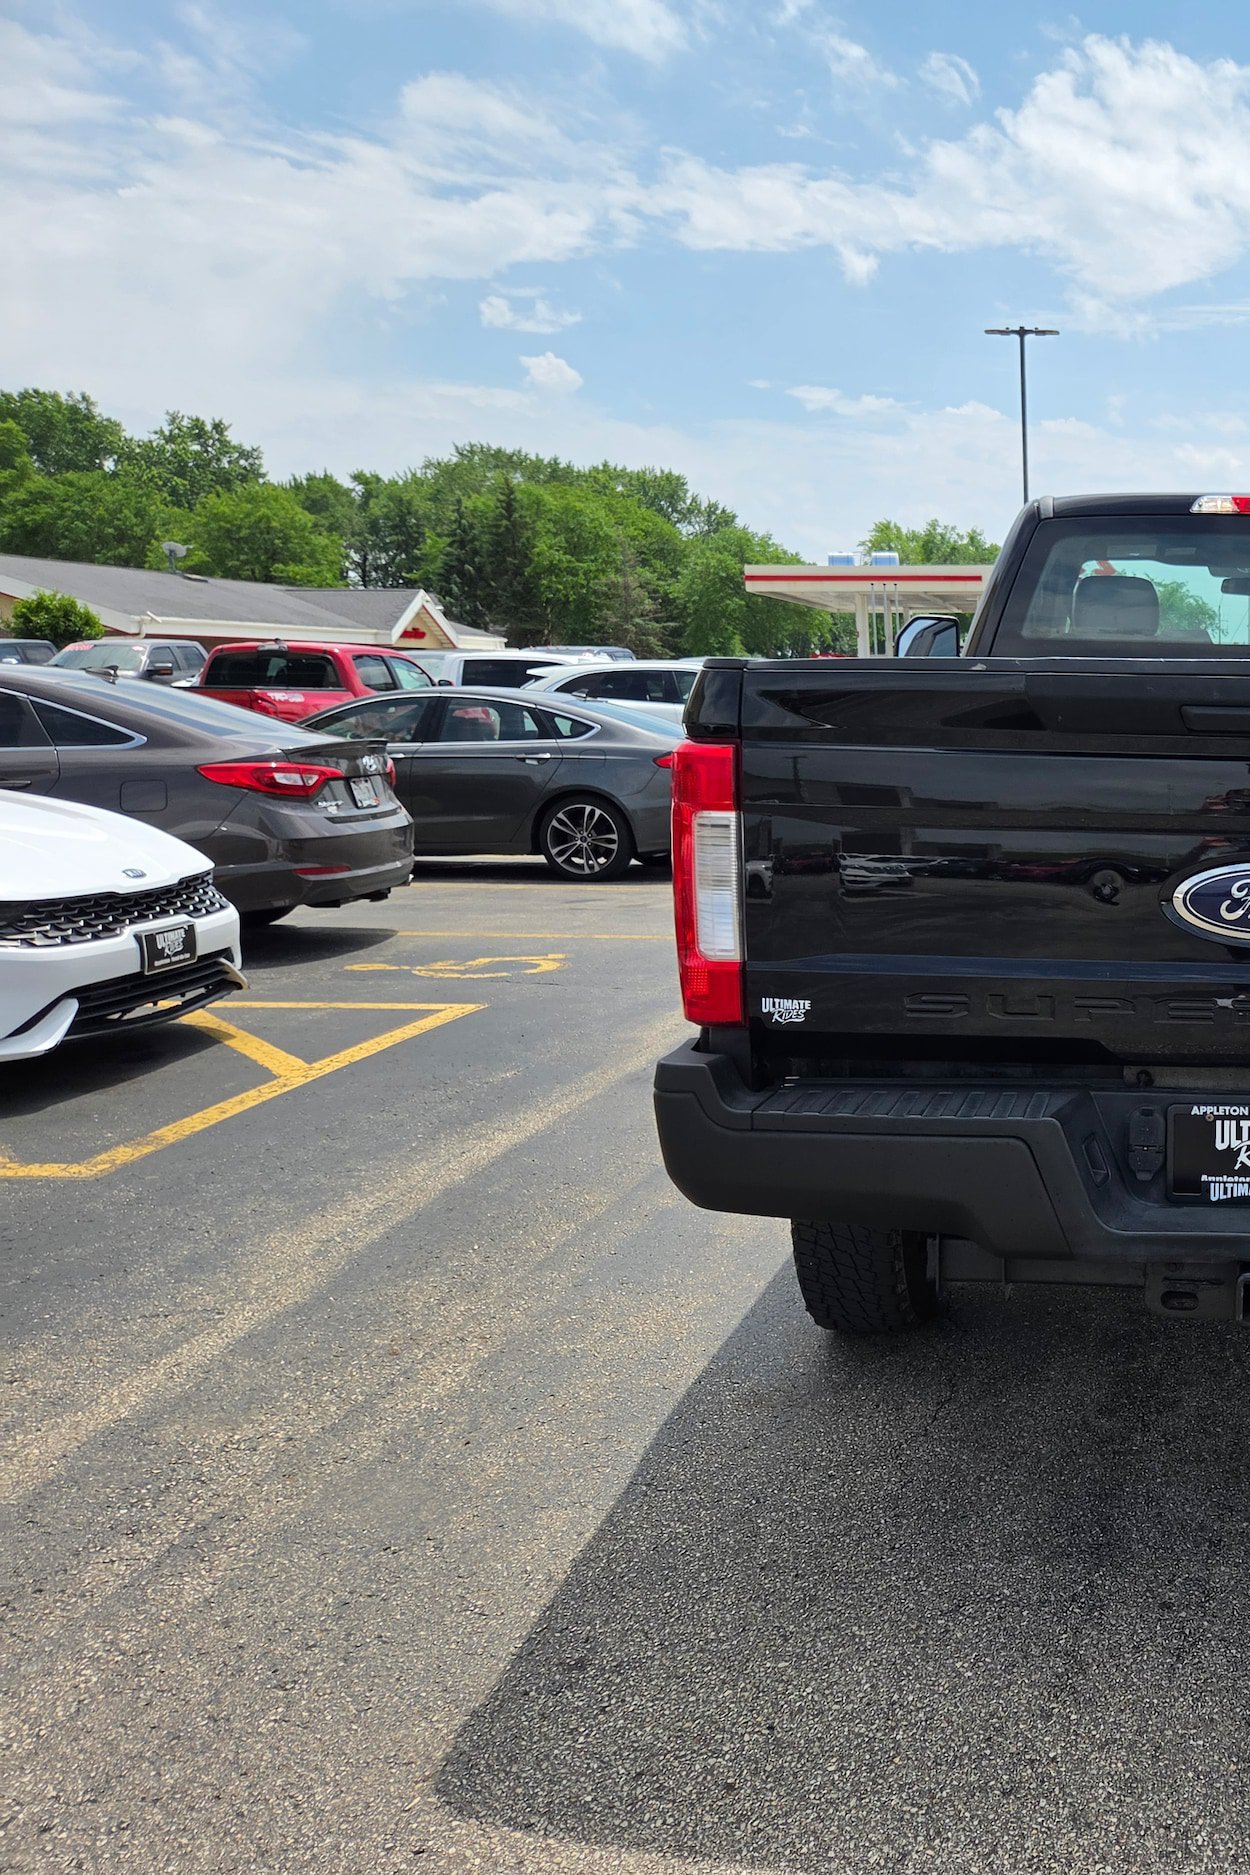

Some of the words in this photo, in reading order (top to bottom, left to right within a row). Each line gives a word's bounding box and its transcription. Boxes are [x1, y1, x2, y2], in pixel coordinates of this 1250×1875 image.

[761, 997, 812, 1013] ULTIMATE
[771, 1008, 807, 1025] RIDES
[1191, 1105, 1249, 1116] APPLETON
